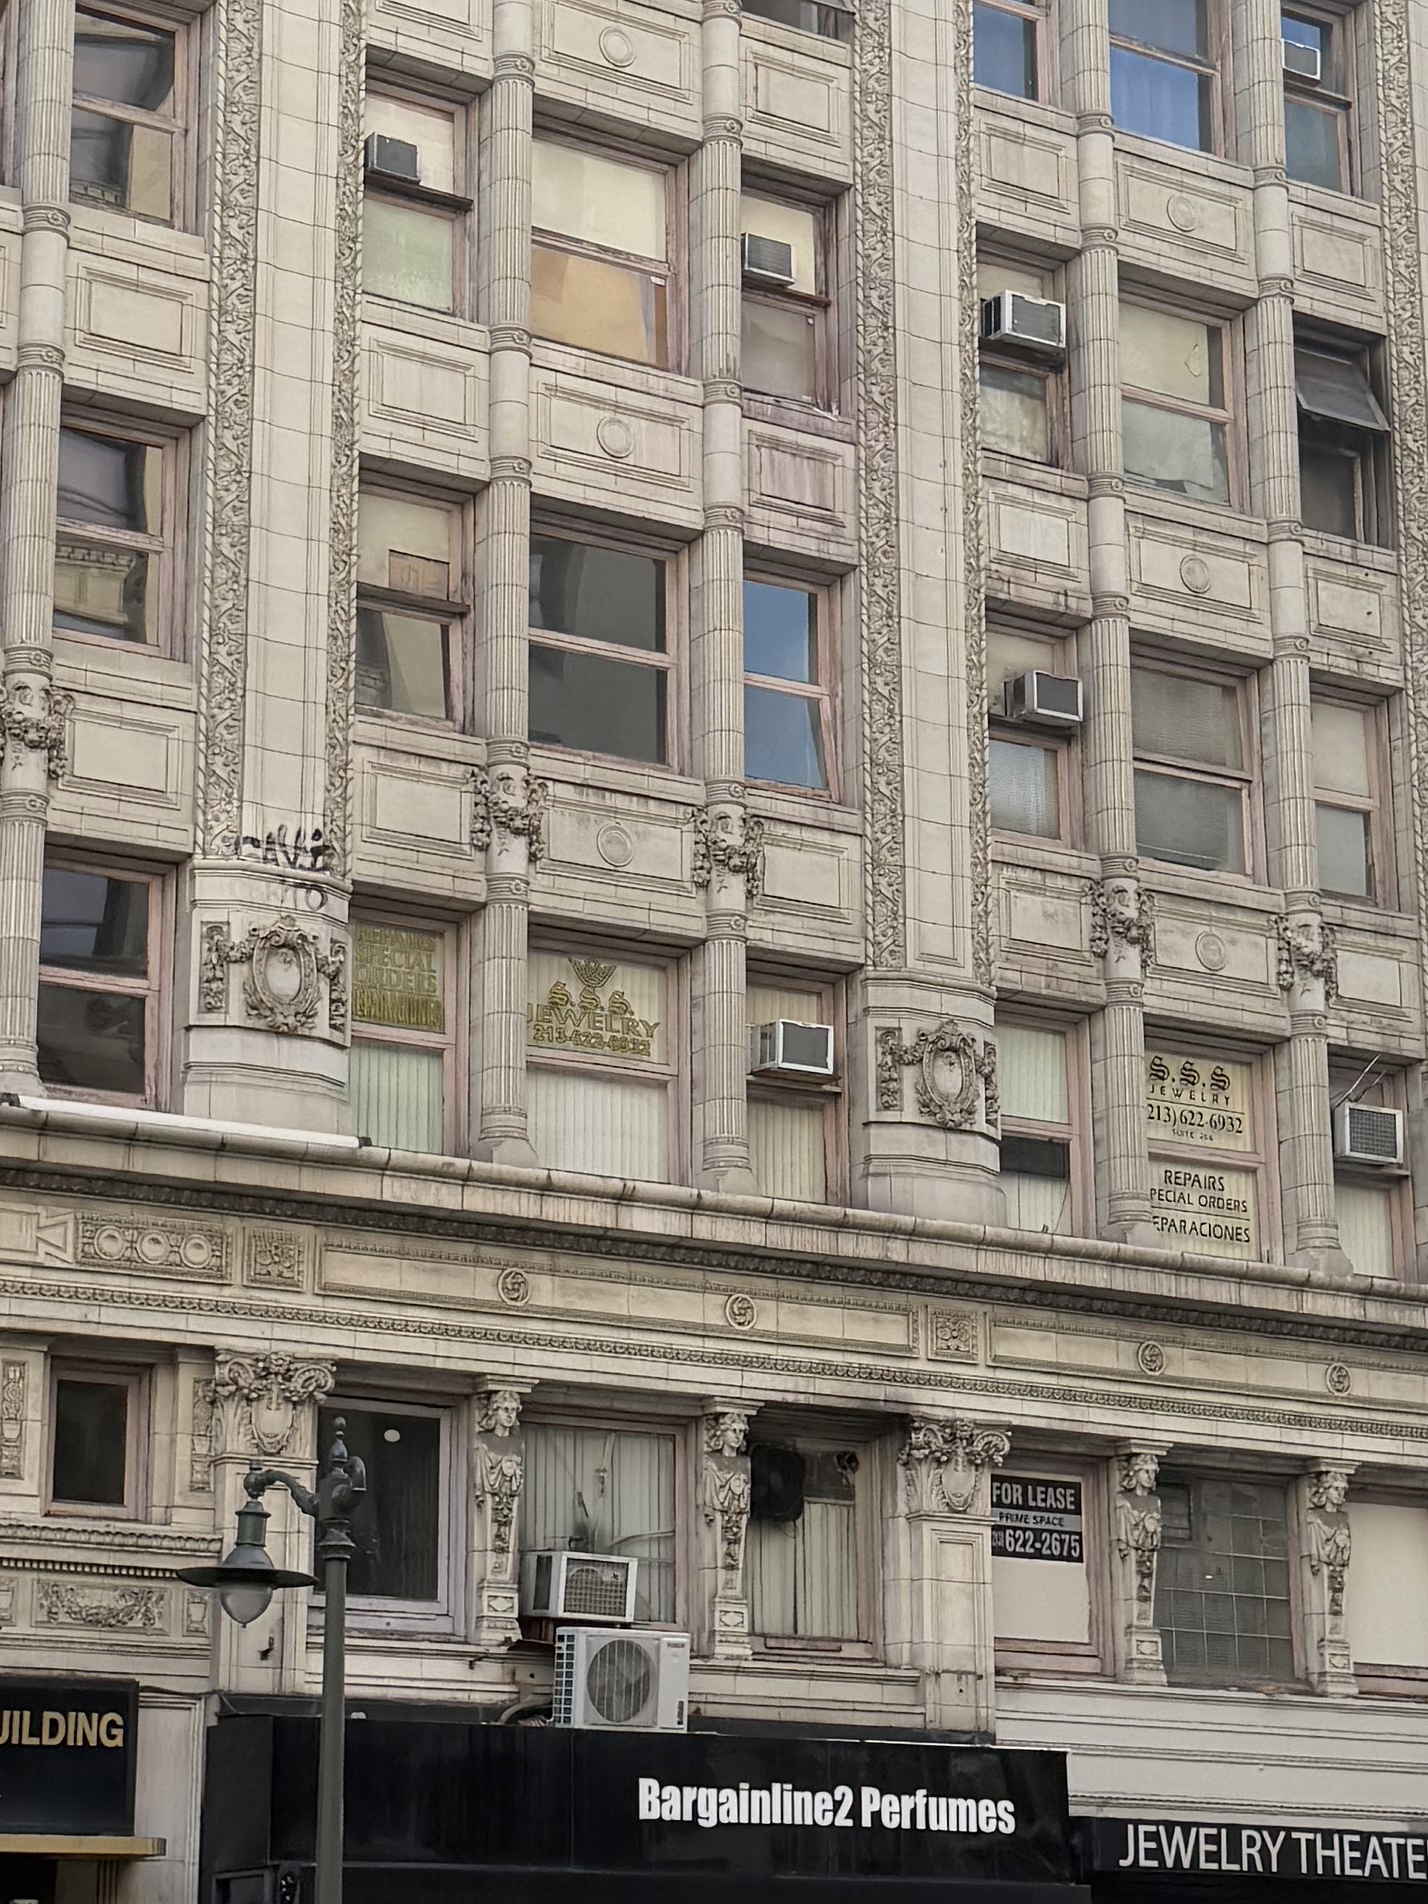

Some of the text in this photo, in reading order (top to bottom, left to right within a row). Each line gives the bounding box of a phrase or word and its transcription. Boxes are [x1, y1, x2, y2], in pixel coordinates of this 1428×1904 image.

[526, 1002, 661, 1039] JEWELRY
[1149, 1084, 1231, 1106] JEWELRY
[1146, 1103, 1178, 1128] 213)
[1164, 1169, 1226, 1192] REPAIRS
[1149, 1187, 1248, 1213] PECIAL ORDERS
[1151, 1215, 1251, 1244] EPARACIONES
[992, 1481, 1076, 1510] FOR LEASE
[998, 1512, 1065, 1527] PRIME SPACE
[1005, 1528, 1081, 1558] 622-2675
[637, 1776, 1017, 1835] Bargainline2 Perfumes
[1117, 1823, 1287, 1876] JEWELRY
